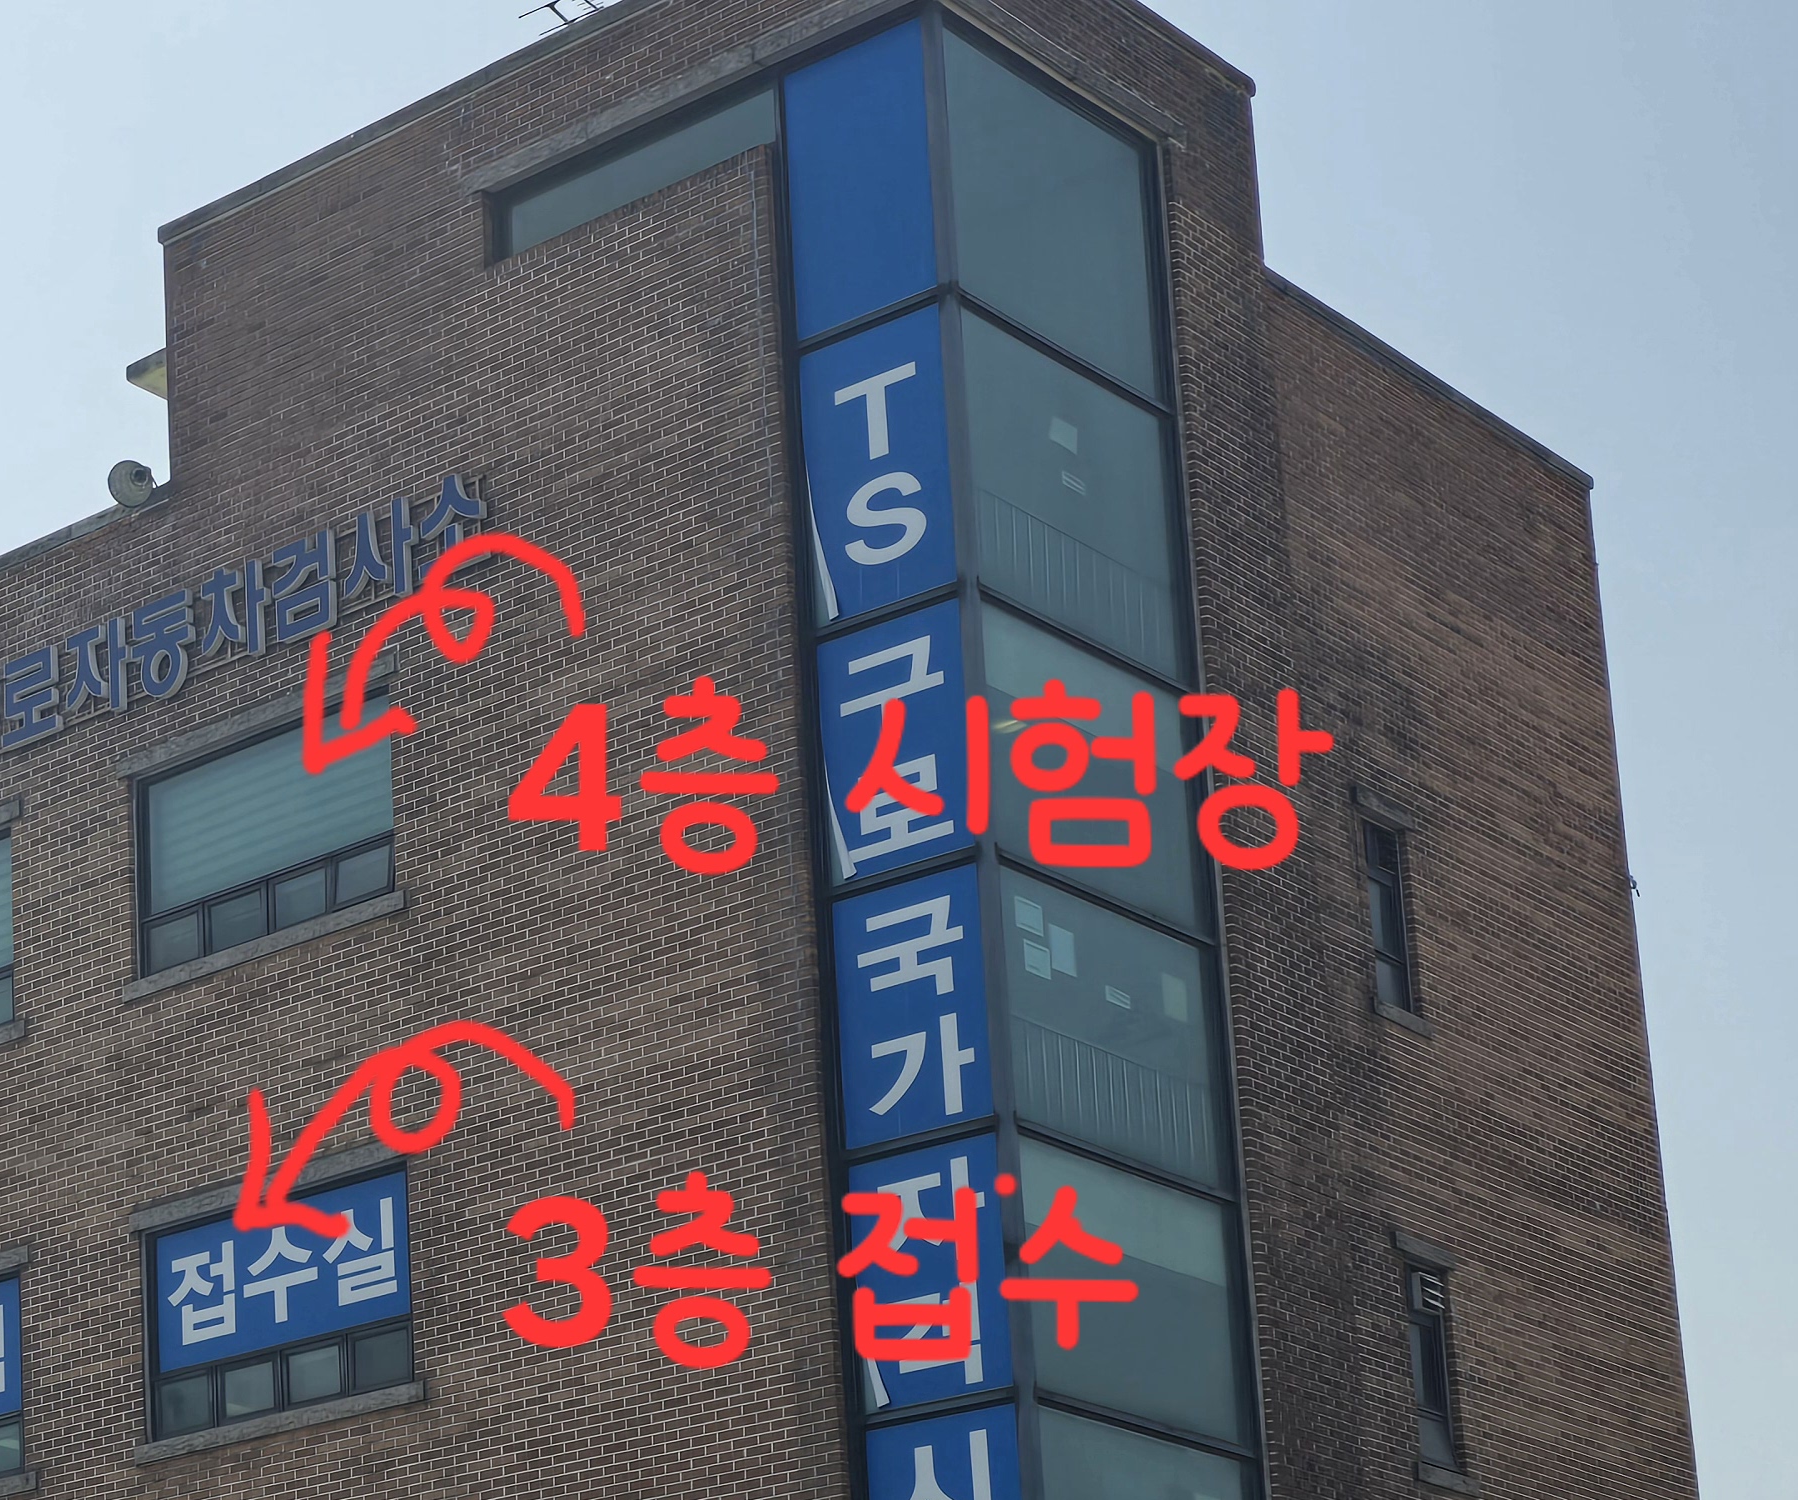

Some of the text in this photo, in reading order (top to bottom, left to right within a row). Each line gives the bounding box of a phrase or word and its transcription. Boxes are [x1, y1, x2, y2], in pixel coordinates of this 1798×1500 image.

[833, 360, 929, 566] TS
[857, 895, 975, 1115] 국가
[165, 1196, 400, 1348] 접수실
